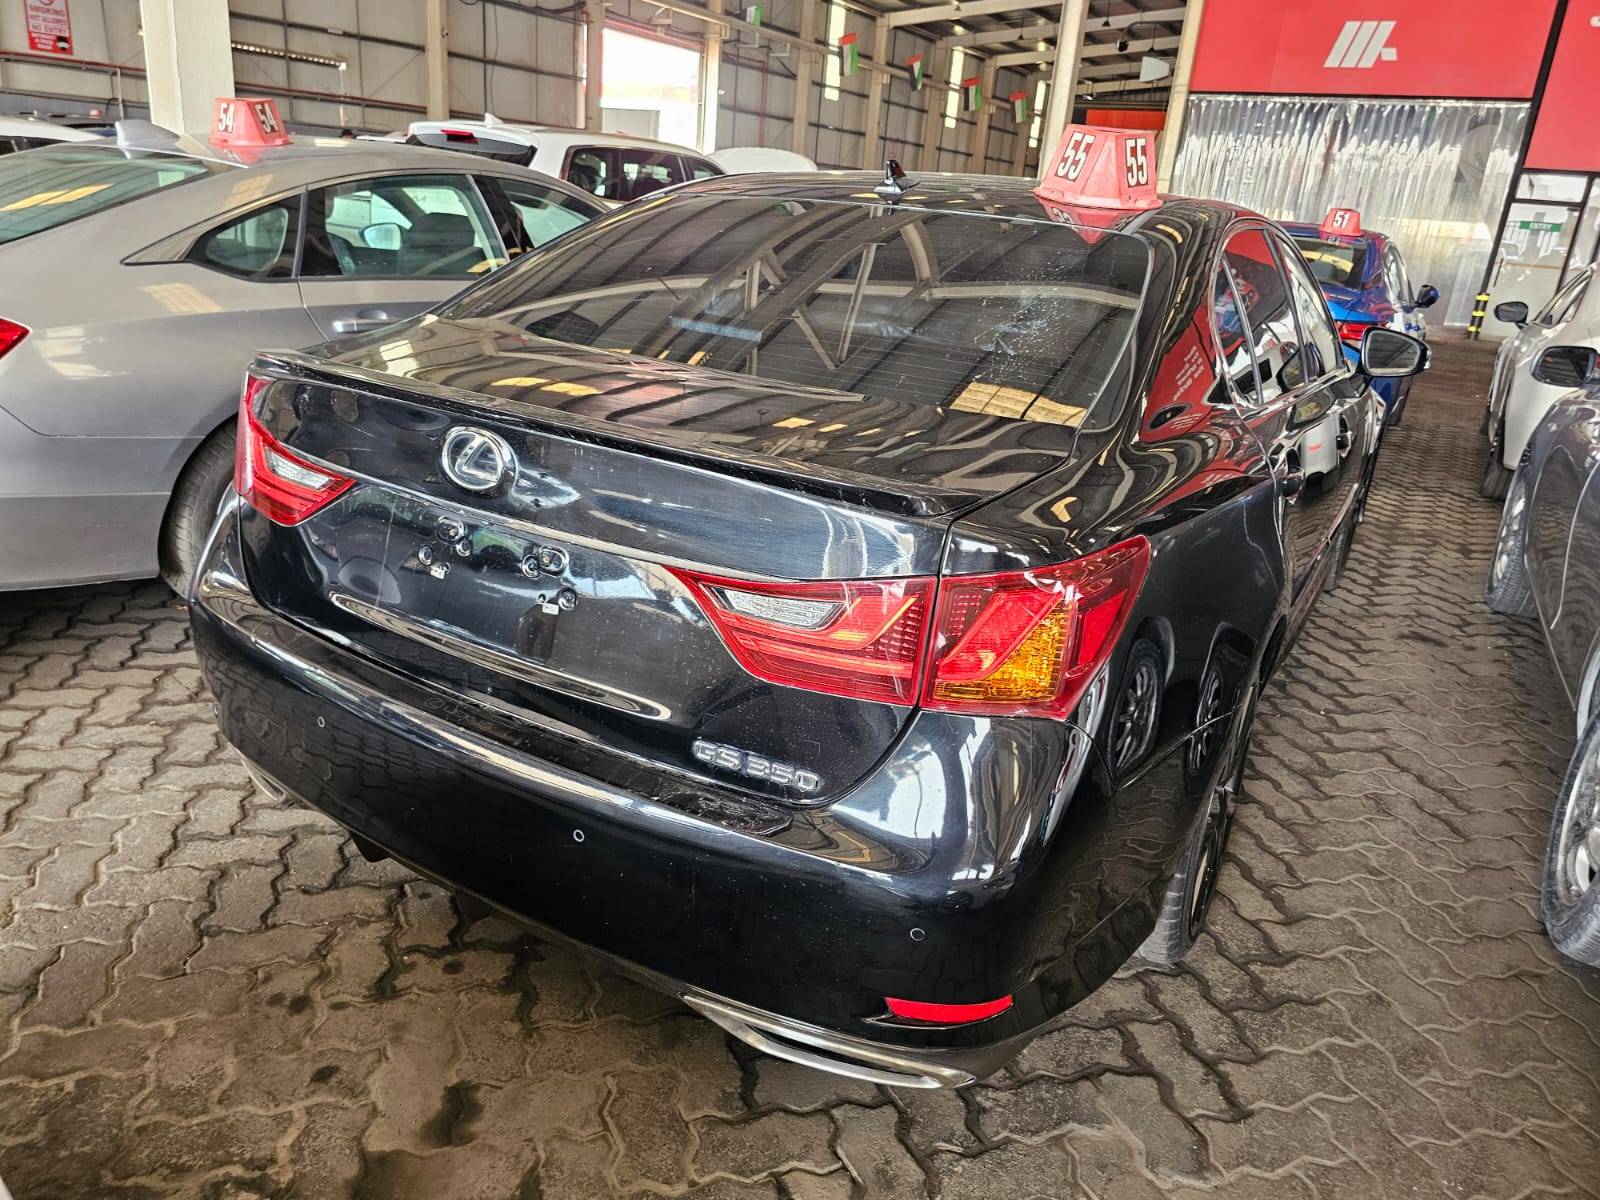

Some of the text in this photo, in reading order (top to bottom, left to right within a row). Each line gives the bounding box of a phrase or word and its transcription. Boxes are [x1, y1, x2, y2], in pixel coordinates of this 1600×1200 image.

[44, 25, 67, 34] ENTRY
[218, 102, 235, 133] 54
[255, 102, 279, 133] 54
[1057, 131, 1096, 180] 55
[1125, 138, 1148, 186] 55
[1333, 211, 1350, 228] 51
[1529, 222, 1552, 231] ENTRY
[693, 740, 742, 770] GS
[746, 754, 821, 792] 350
